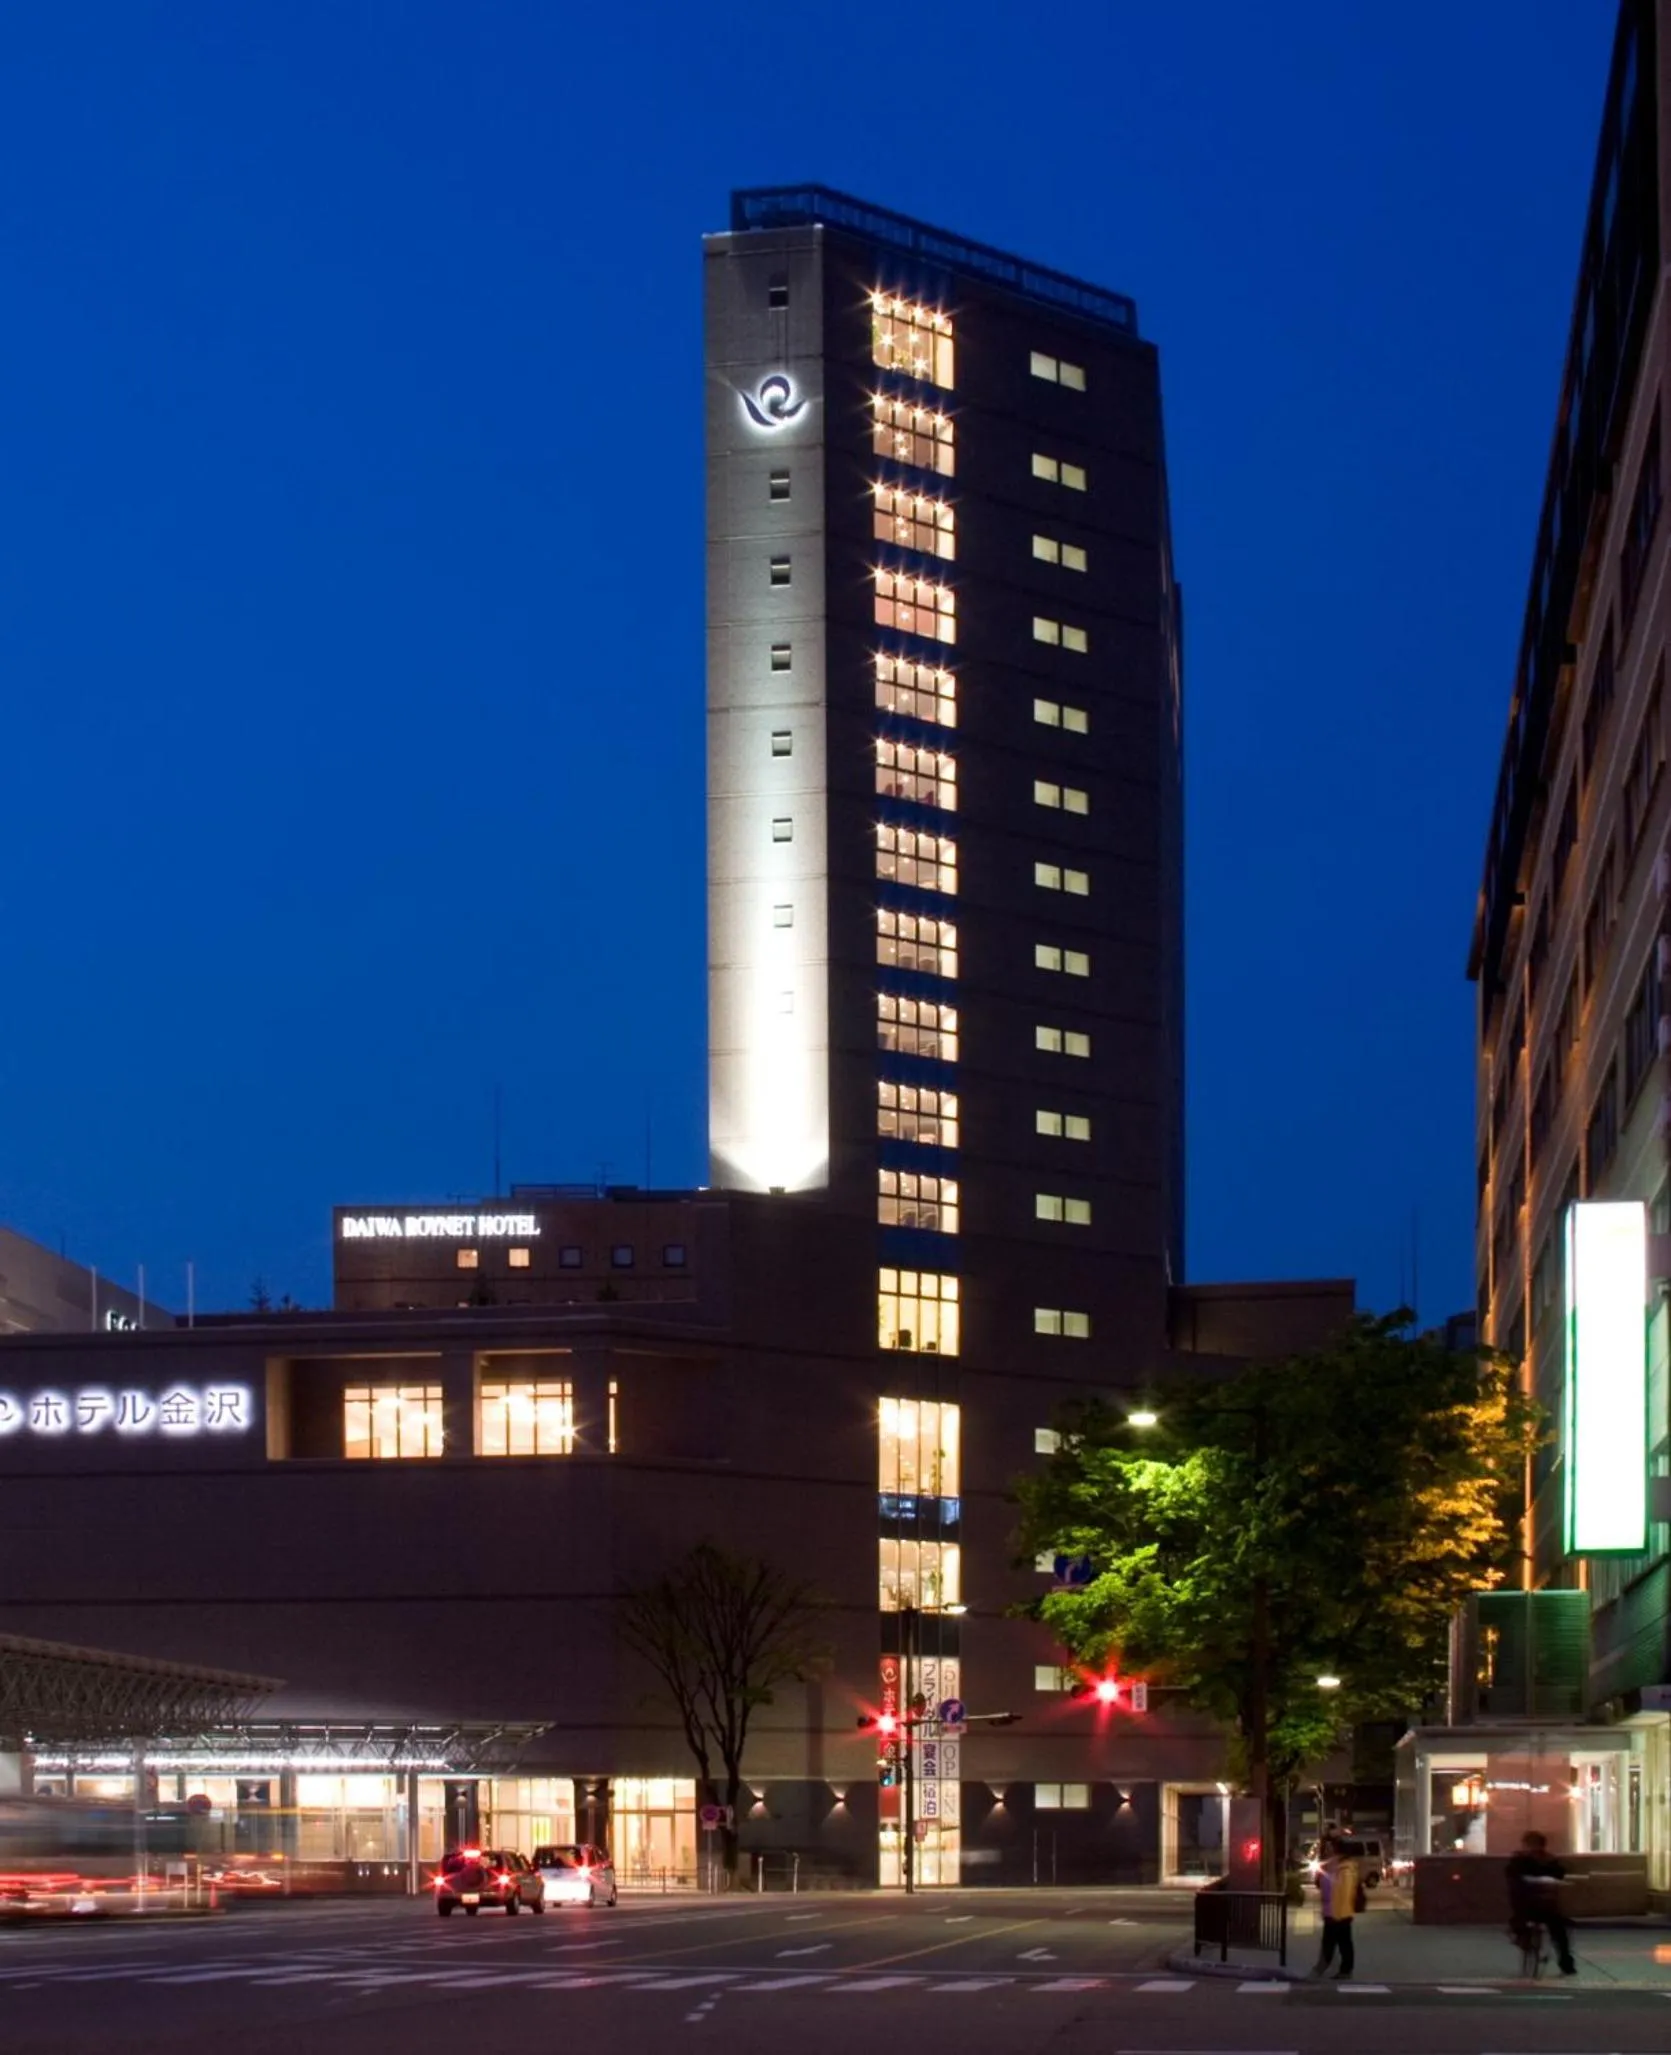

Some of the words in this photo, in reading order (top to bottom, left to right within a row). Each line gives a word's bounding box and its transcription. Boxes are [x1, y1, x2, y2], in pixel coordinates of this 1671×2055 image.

[342, 1216, 403, 1238] DAIWA
[405, 1215, 475, 1236] ROYNET
[477, 1214, 541, 1236] HOTEL
[31, 1391, 243, 1427] ホテル金沢
